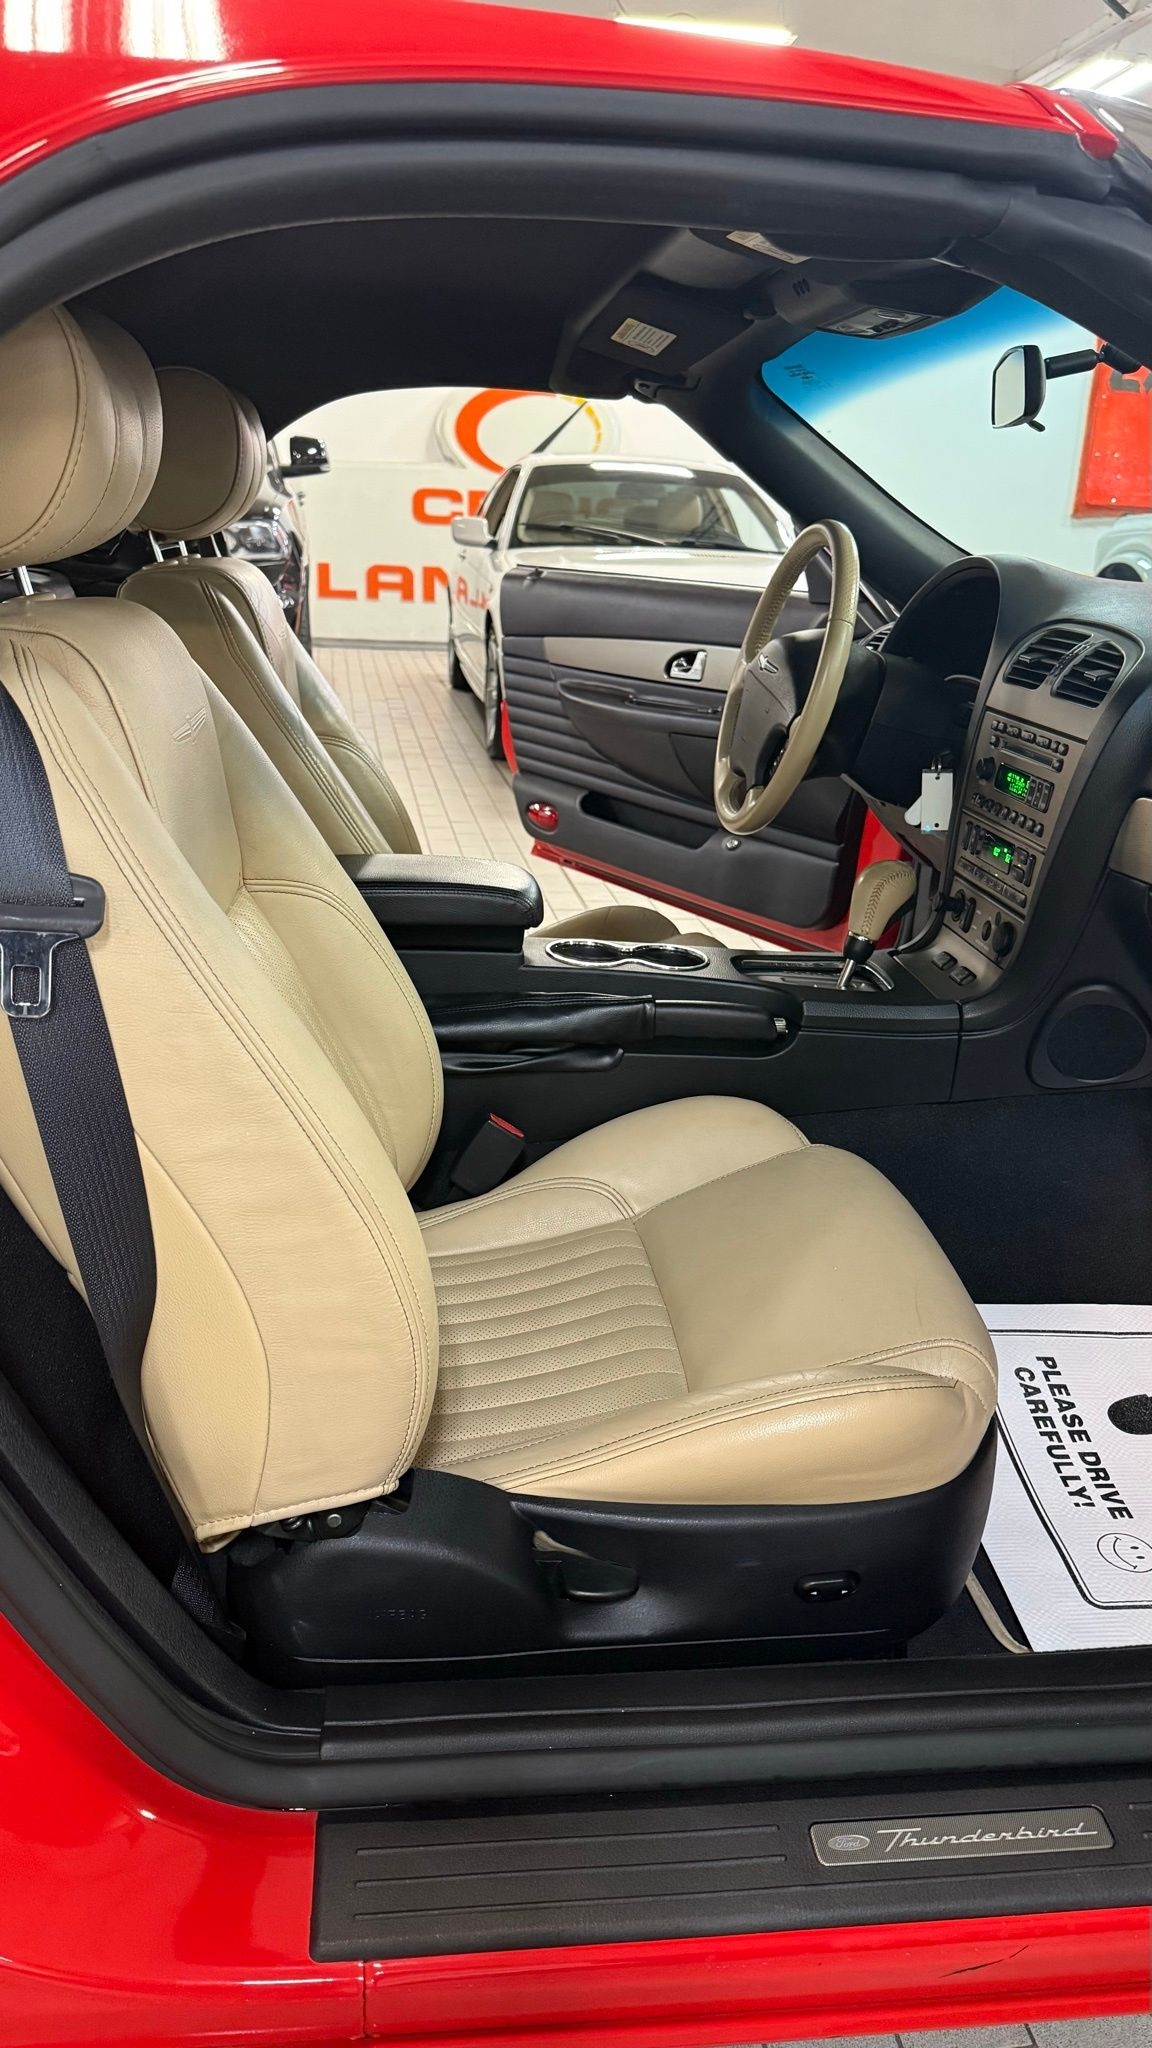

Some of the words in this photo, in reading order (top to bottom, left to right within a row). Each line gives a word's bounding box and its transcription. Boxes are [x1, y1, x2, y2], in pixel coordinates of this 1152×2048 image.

[1014, 1367, 1096, 1508] CAREFULLY!
[1036, 1356, 1092, 1443] PLEASE
[1078, 1451, 1134, 1520] DRIVE
[832, 1836, 864, 1849] Ford
[877, 1822, 1098, 1852] Thunderbird
